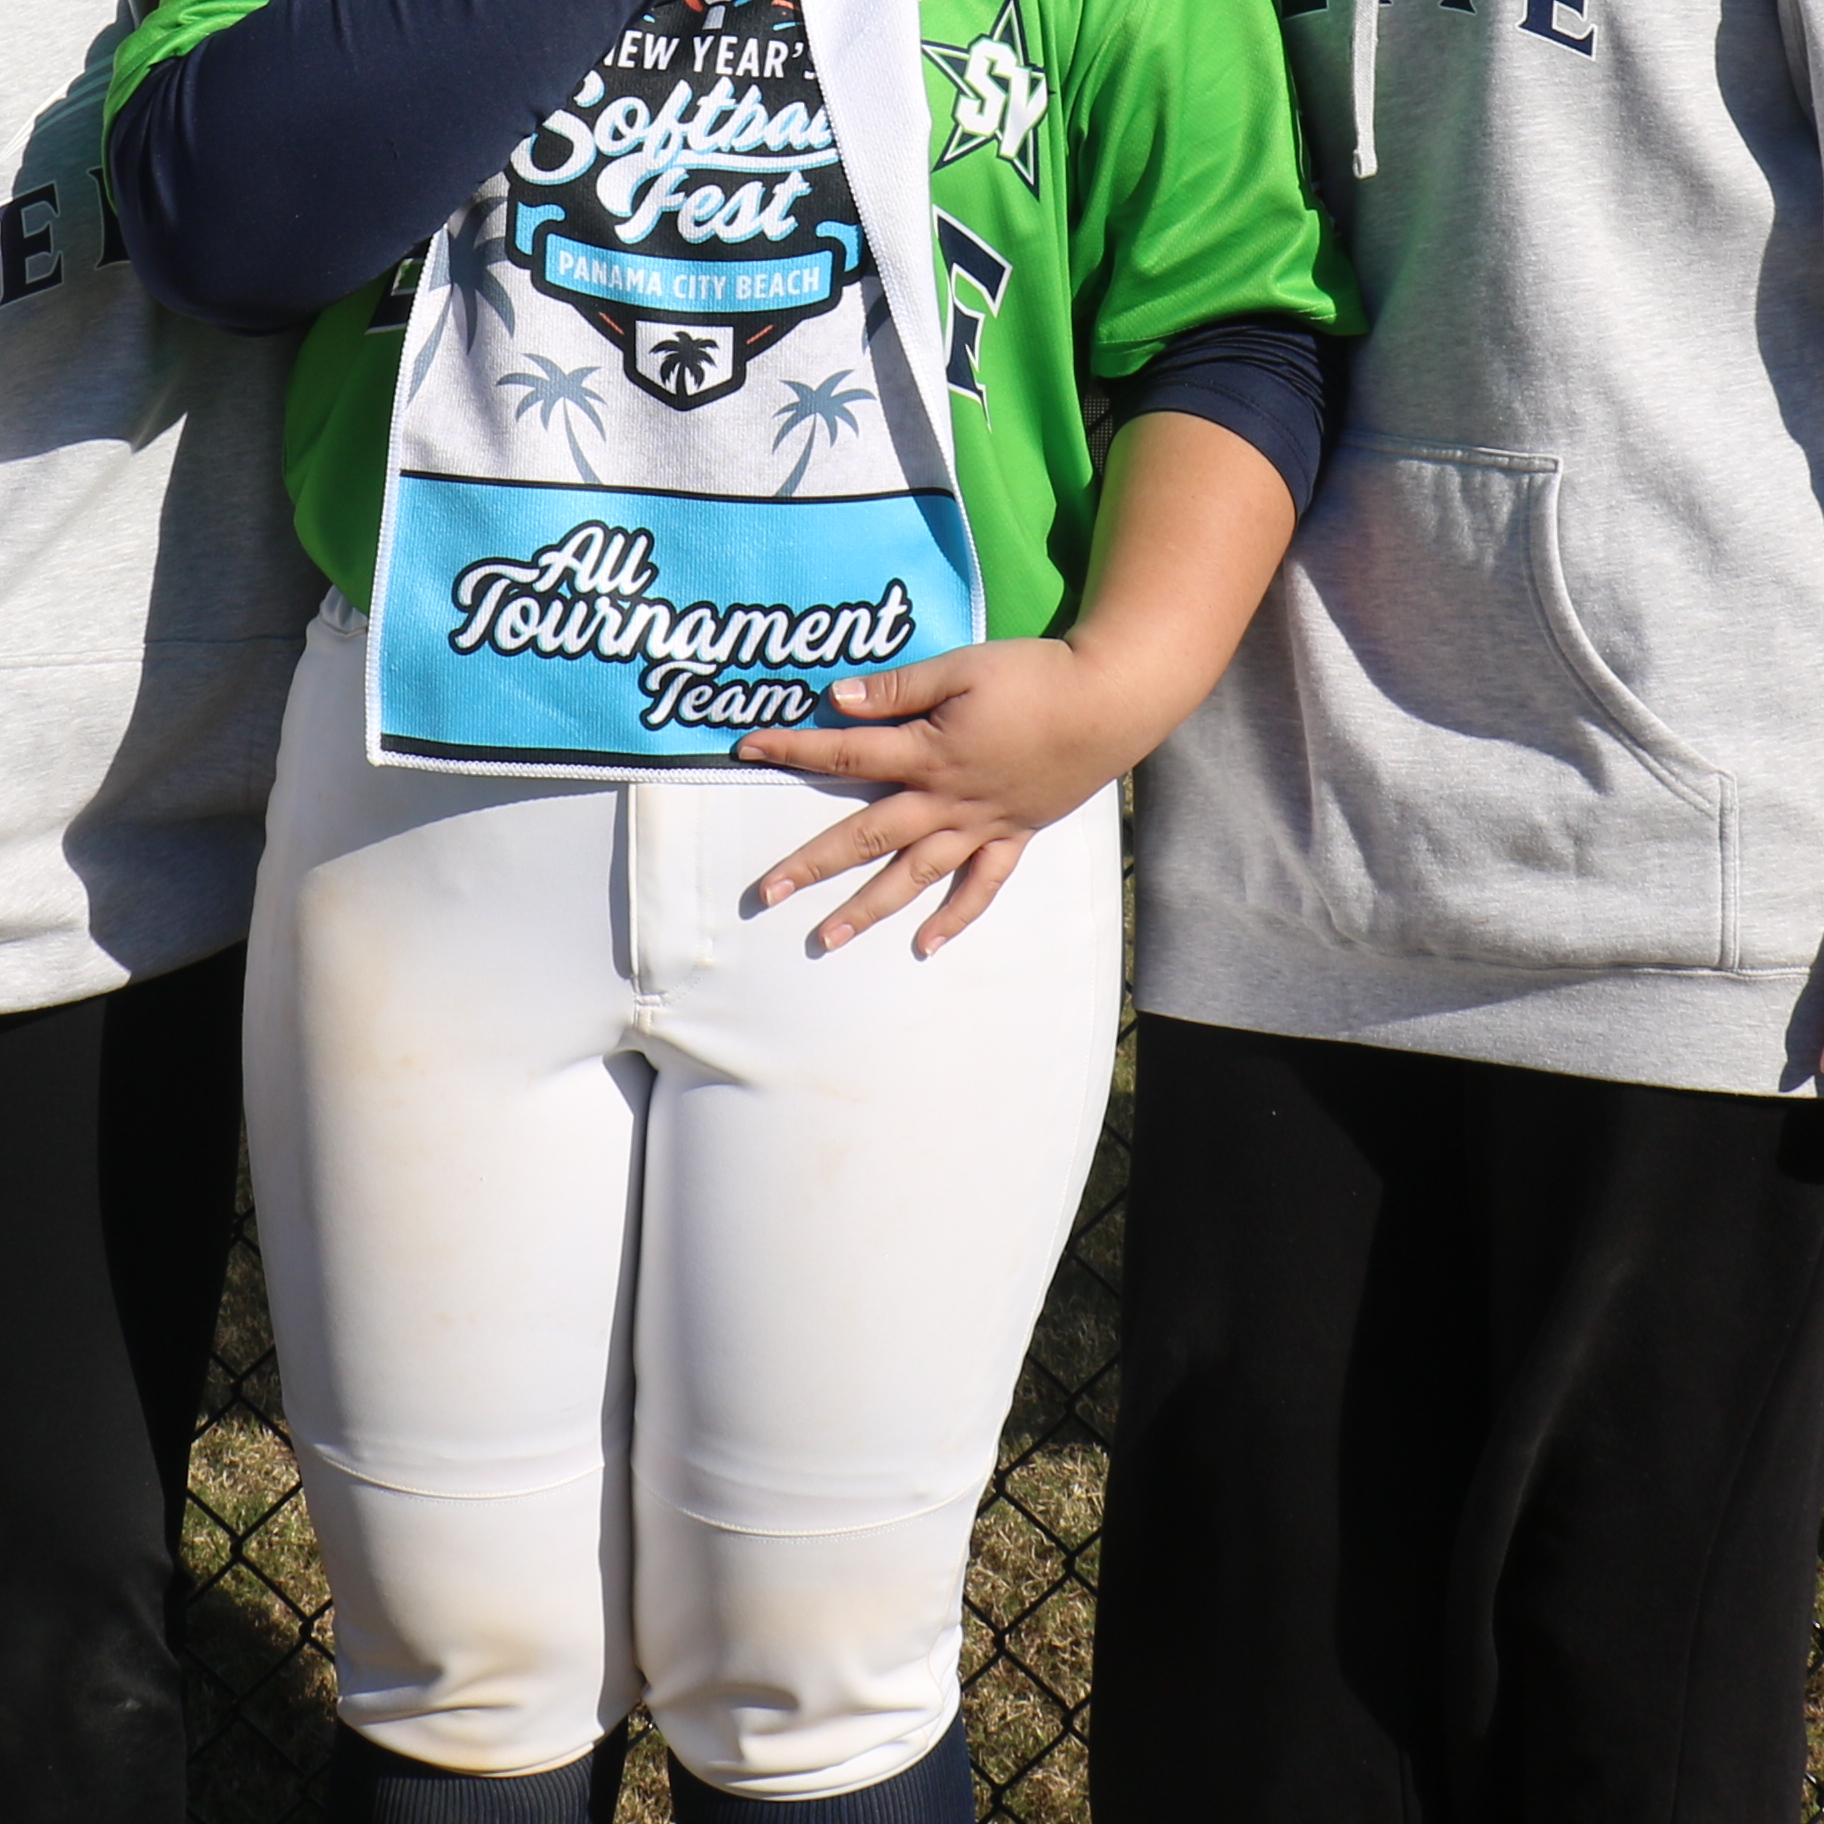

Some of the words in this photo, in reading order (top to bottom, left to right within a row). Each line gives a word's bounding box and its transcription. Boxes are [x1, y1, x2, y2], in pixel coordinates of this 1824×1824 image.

[692, 34, 818, 80] YEAR'
[510, 70, 834, 186] Softba
[596, 150, 813, 244] Fest
[558, 249, 664, 297] PANAMA
[673, 273, 727, 300] CITY
[735, 265, 821, 300] BEACH
[532, 521, 655, 596] All
[451, 559, 913, 666] Tournament
[638, 657, 816, 728] Team
